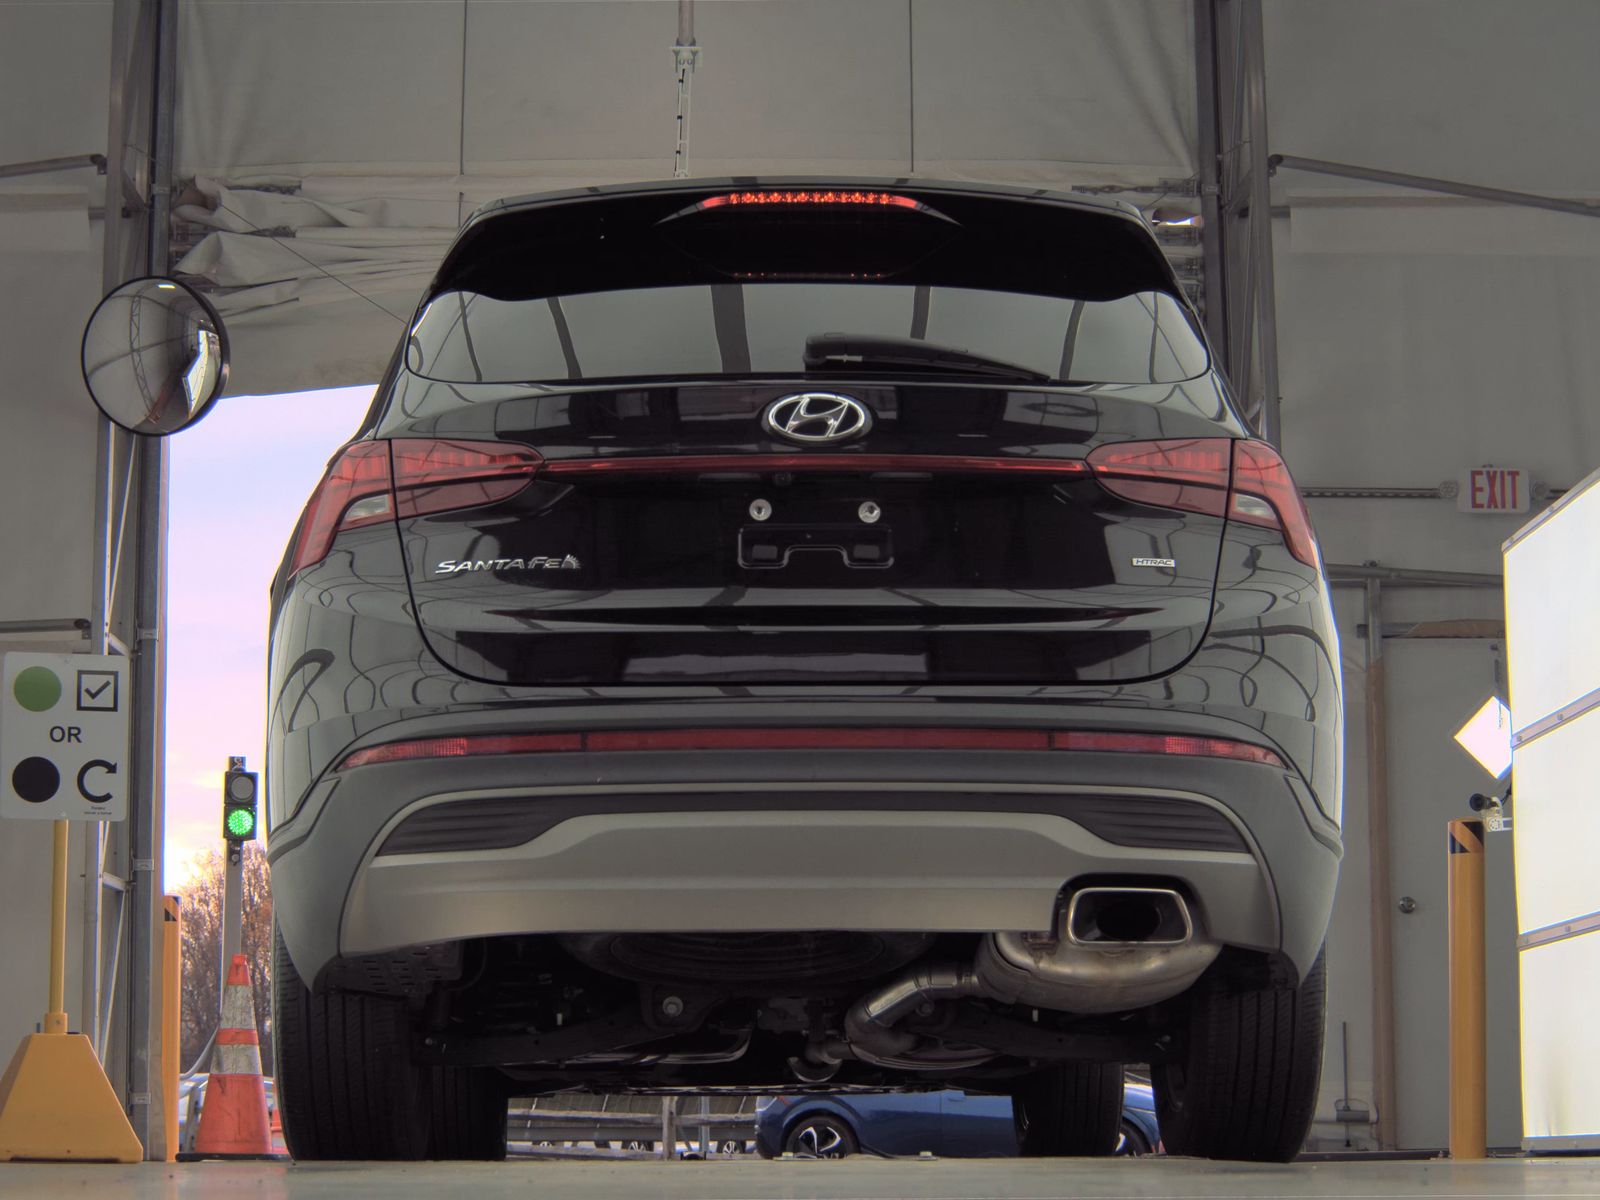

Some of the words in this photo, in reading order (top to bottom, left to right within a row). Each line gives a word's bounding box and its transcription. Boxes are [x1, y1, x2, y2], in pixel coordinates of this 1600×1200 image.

[1470, 469, 1520, 509] EXIT
[435, 558, 525, 574] SANTA
[49, 725, 82, 743] OR
